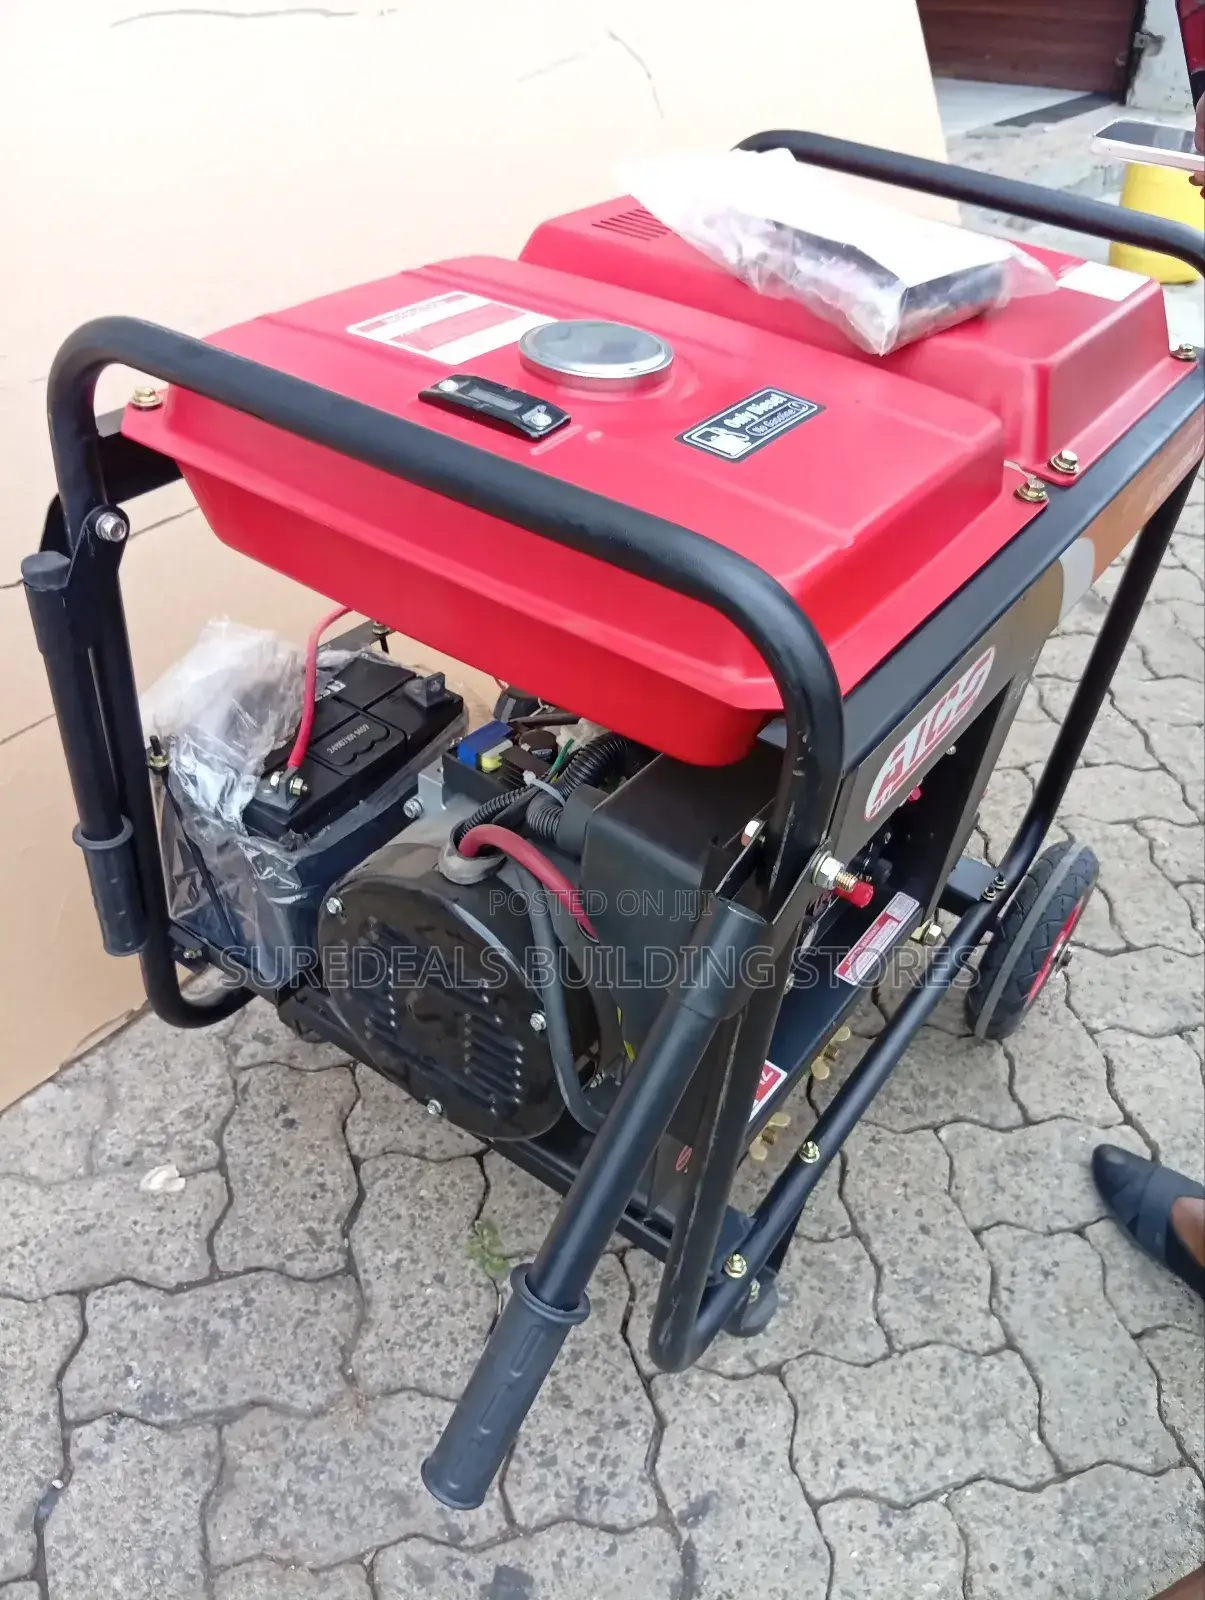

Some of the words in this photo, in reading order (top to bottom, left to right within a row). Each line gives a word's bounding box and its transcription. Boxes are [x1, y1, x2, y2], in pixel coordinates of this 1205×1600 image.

[723, 410, 759, 429] Only
[746, 393, 788, 415] Diesel
[751, 425, 768, 434] No
[763, 408, 796, 427] Gasoline
